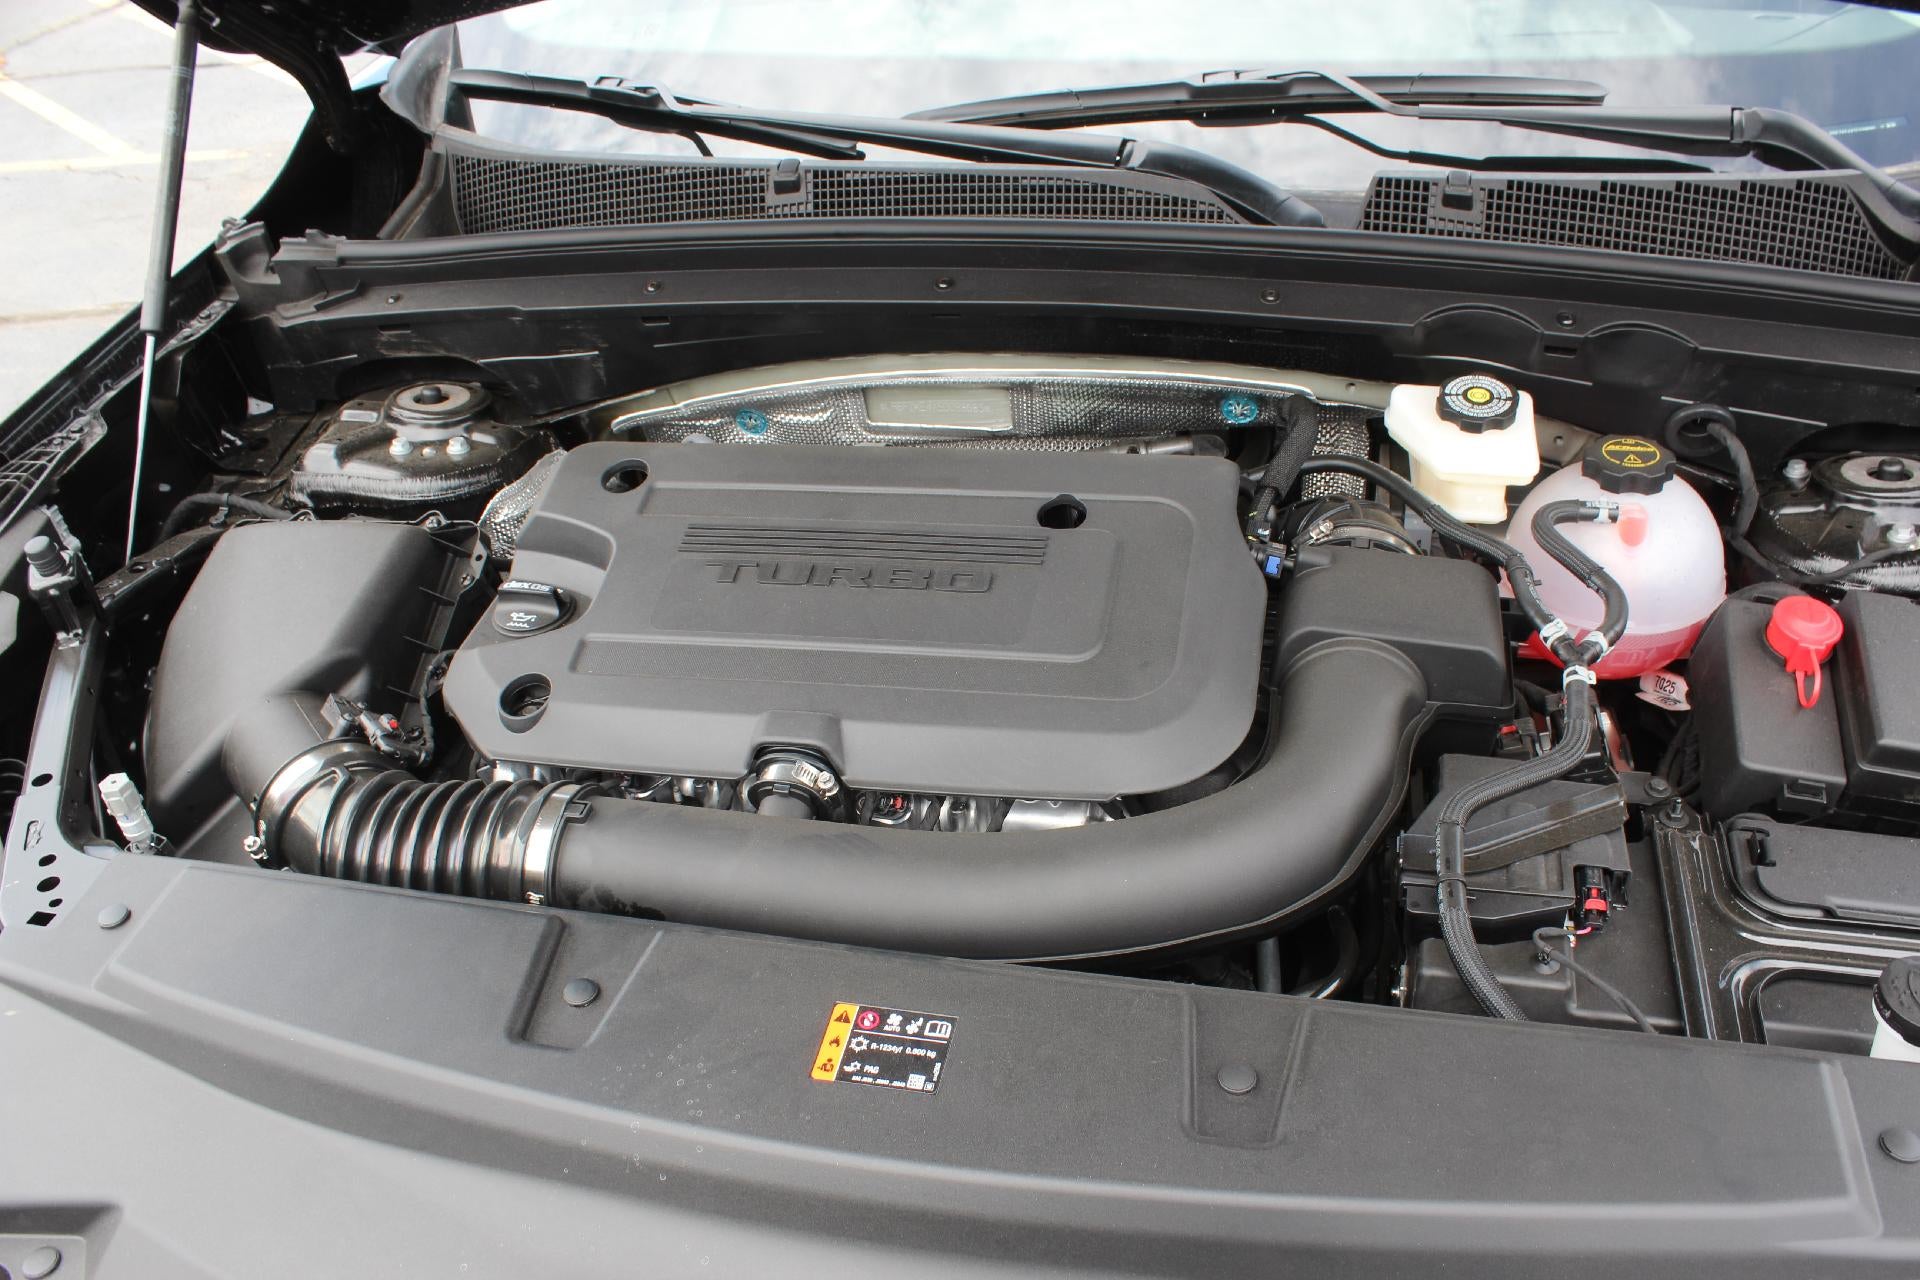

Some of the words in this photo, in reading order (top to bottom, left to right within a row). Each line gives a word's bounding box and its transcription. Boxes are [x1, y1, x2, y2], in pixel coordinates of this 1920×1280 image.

[706, 561, 994, 593] TURBO
[1655, 675, 1676, 694] 7025
[883, 1025, 901, 1033] AUTO
